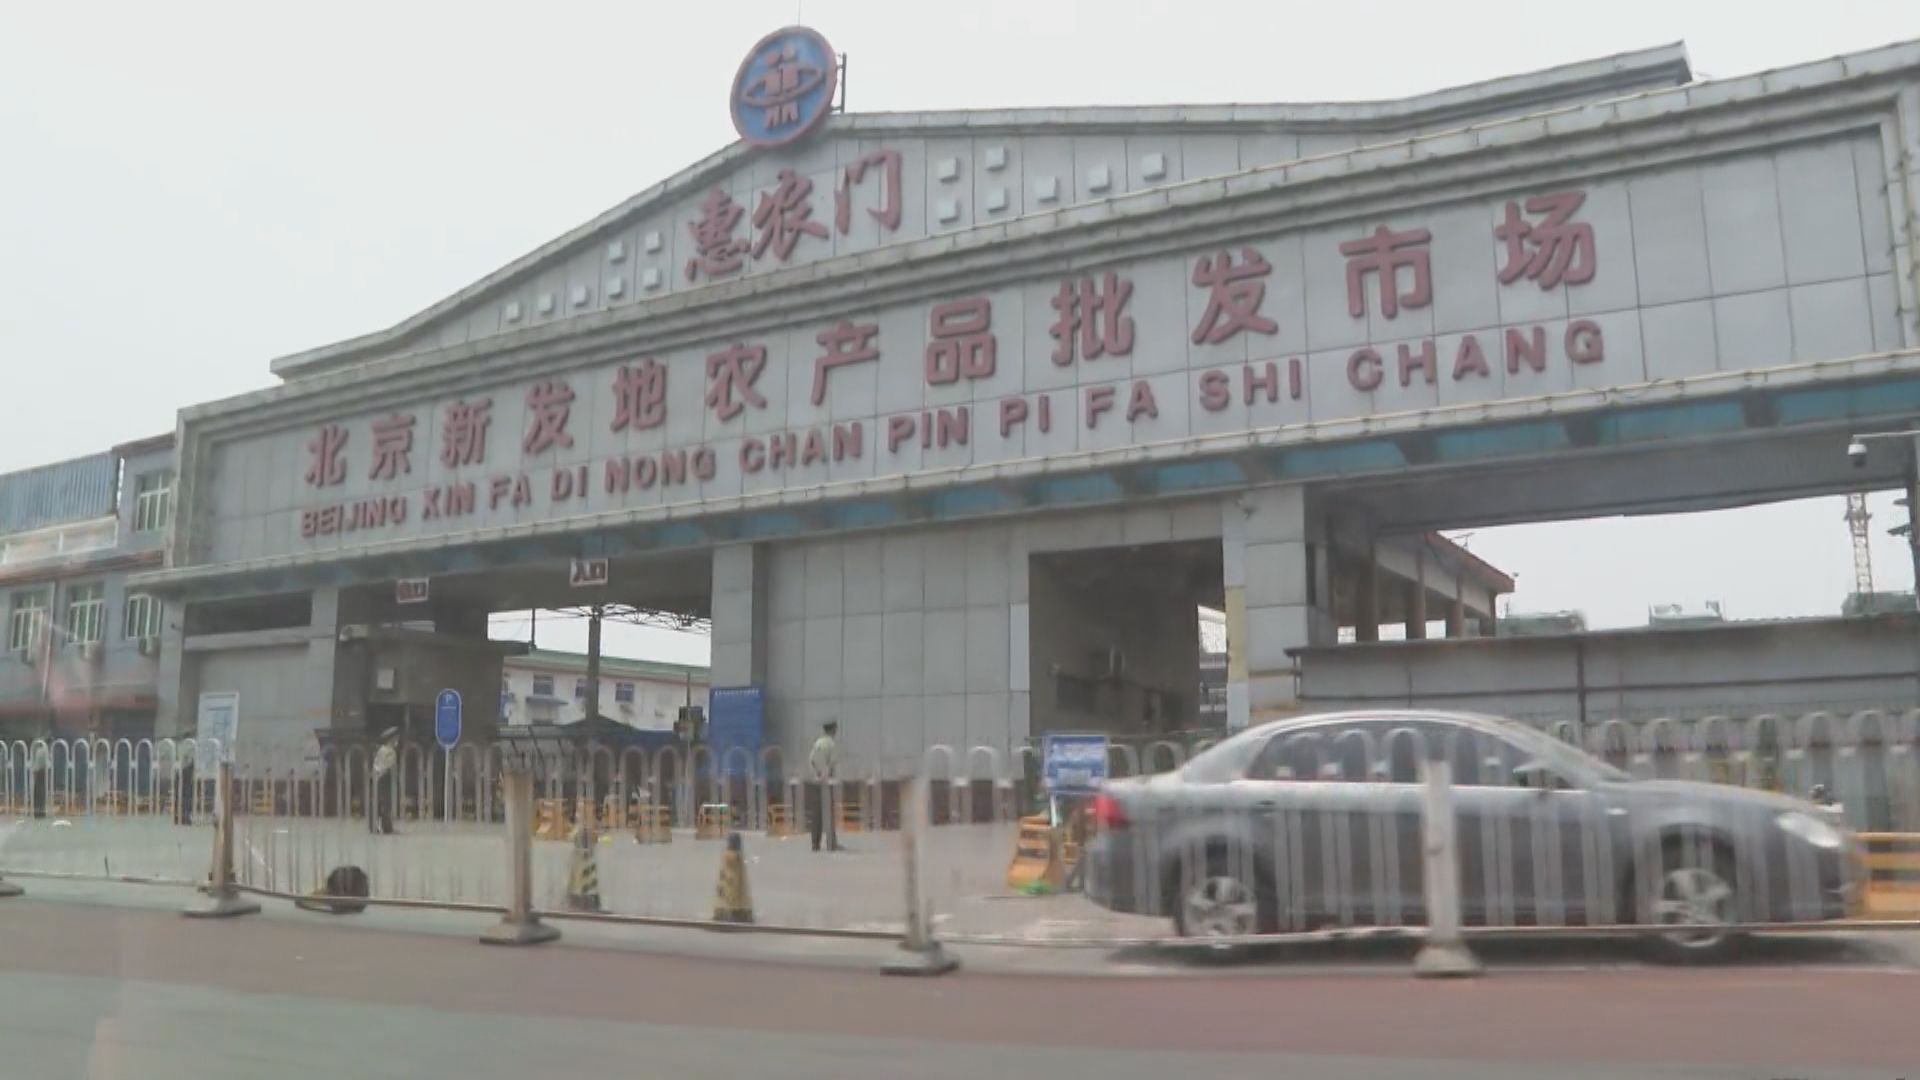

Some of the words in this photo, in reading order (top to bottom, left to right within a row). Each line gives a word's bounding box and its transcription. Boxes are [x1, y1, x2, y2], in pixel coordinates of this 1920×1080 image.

[685, 147, 901, 282] 惠农门
[302, 497, 407, 537] BEIJING
[422, 482, 475, 520] XIN
[490, 475, 532, 510] FA
[552, 466, 588, 501] DI
[604, 448, 716, 493] NONG
[739, 422, 864, 473] CHAN
[888, 406, 969, 453] PIN
[999, 394, 1050, 438] PI
[1085, 380, 1158, 428] FA
[1199, 358, 1301, 411] SHI
[1347, 319, 1604, 392] CHANG
[303, 190, 1597, 488] 北京新发地农产品批发市场
